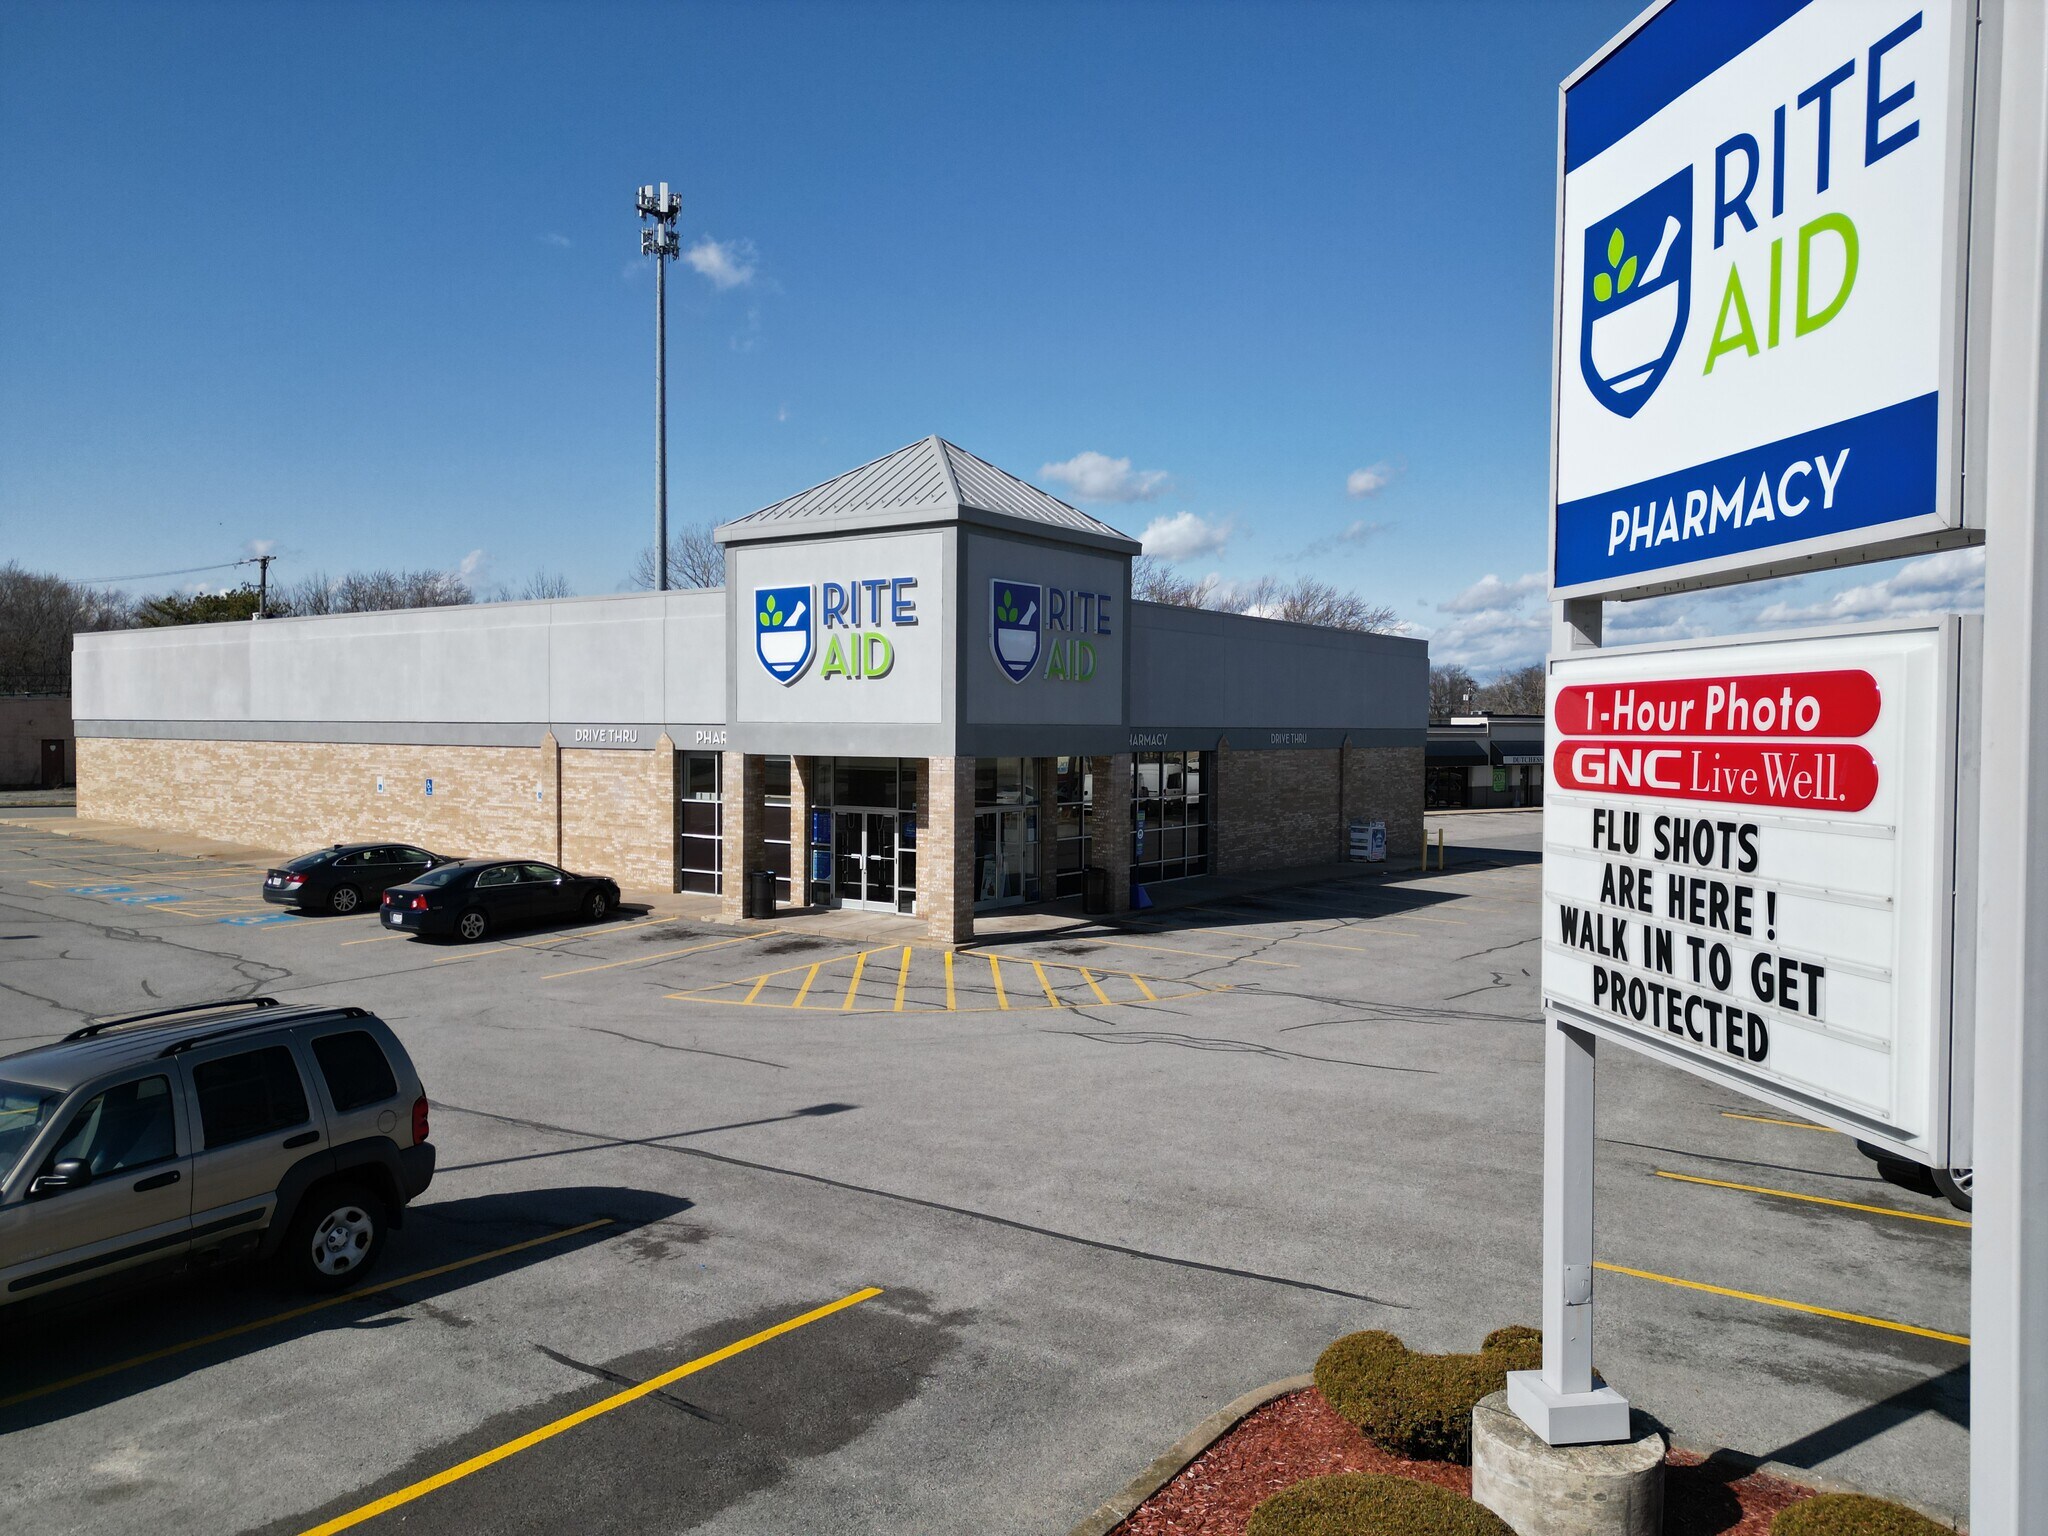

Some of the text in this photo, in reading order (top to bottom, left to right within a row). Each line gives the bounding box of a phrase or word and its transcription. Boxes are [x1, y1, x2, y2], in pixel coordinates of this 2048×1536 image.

[1713, 10, 1923, 251] RITE
[1702, 211, 1860, 377] AID
[1607, 448, 1851, 557] PHARMACY
[822, 576, 919, 628] RITE
[1044, 587, 1112, 636] RITE
[819, 631, 895, 680] AID
[1043, 637, 1098, 682] AID
[1584, 681, 1821, 732] 1-Hour Photo
[575, 728, 639, 743] DRIVE THRU
[1270, 733, 1307, 744] DRIVE THRU
[1571, 747, 1847, 803] GNC Live Well.
[1592, 808, 1760, 873] FLU SHOTS
[1600, 862, 1653, 913] ARE
[1668, 873, 1753, 936] HERE
[1560, 904, 1825, 1017] WALK IN TO GET
[1592, 964, 1768, 1063] PROTECTED
